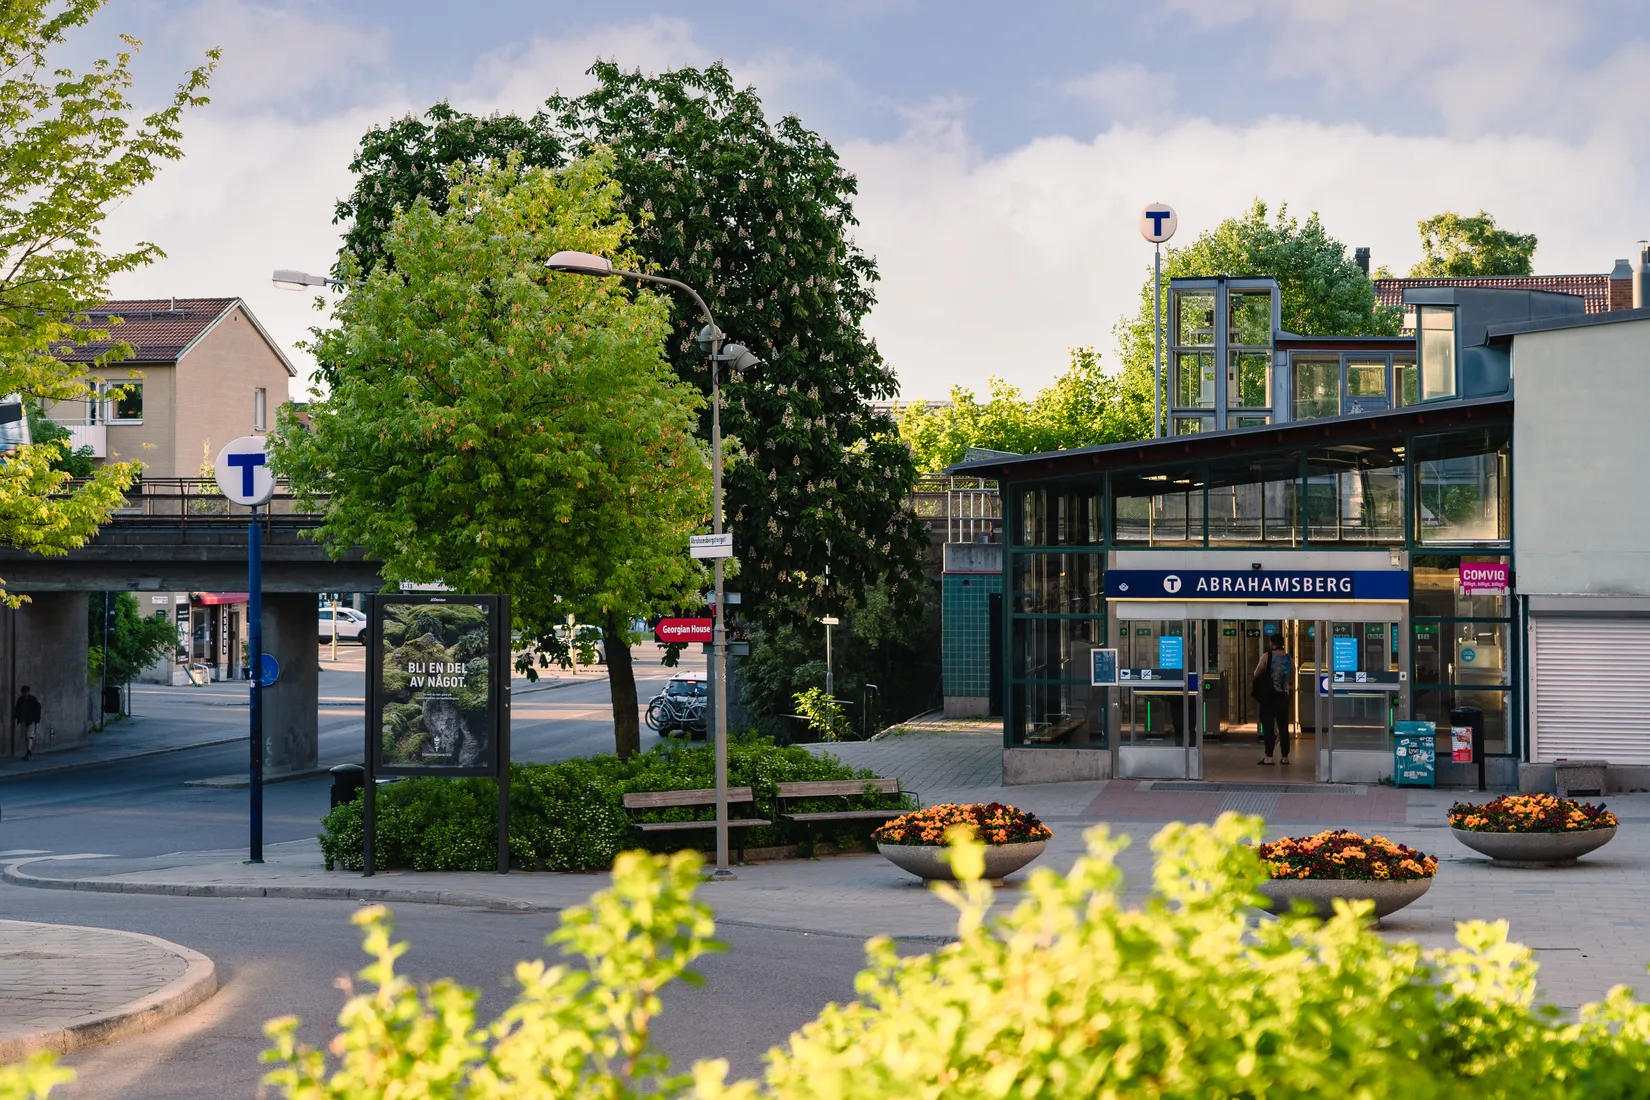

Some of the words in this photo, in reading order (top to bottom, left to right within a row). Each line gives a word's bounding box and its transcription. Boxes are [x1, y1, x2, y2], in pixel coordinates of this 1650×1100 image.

[1145, 211, 1170, 236] T
[227, 453, 266, 497] T
[1463, 569, 1505, 581] COMVIQ
[1196, 577, 1352, 592] ABRAHAMSBERG
[662, 625, 691, 635] Georgian
[691, 625, 711, 633] House
[408, 662, 426, 674] BLI
[429, 662, 444, 674] EN
[447, 662, 468, 674] DEL
[409, 676, 425, 688] AV
[427, 673, 467, 688] NÅGOT.
